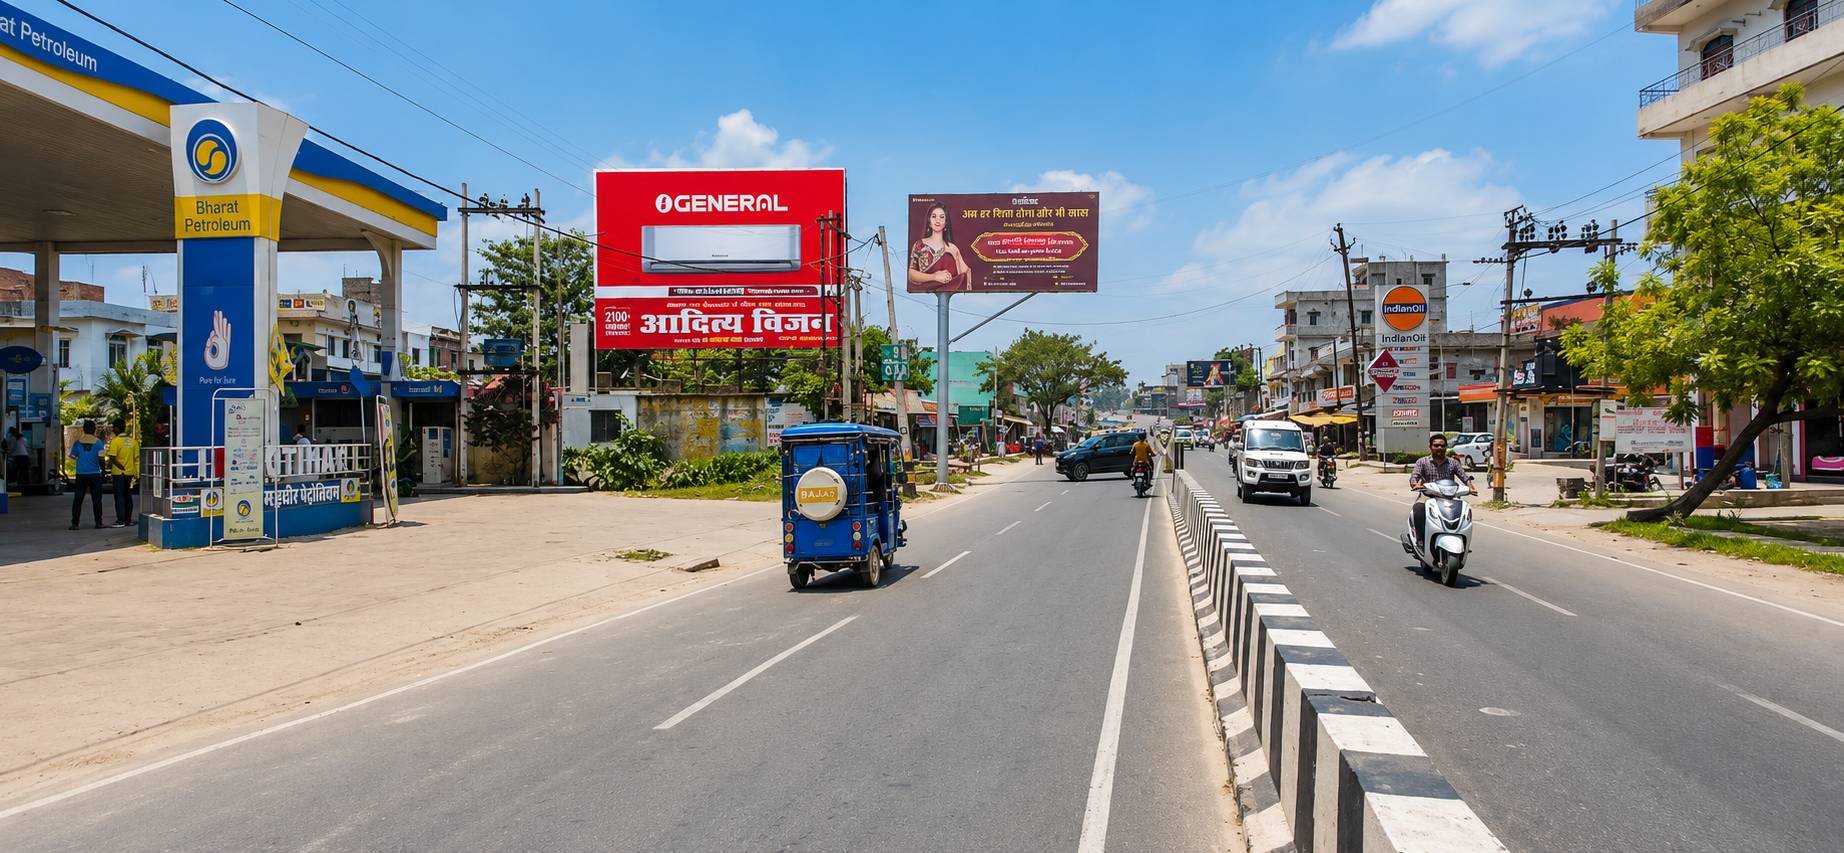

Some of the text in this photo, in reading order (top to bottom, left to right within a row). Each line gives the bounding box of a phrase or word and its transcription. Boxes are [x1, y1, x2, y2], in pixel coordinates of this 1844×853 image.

[20, 20, 97, 72] Petroleum
[196, 200, 239, 215] Bharat
[673, 193, 789, 213] GENERAL
[184, 217, 251, 233] Petroleum
[1384, 304, 1425, 313] IndianOil
[640, 307, 744, 334] आदित्य
